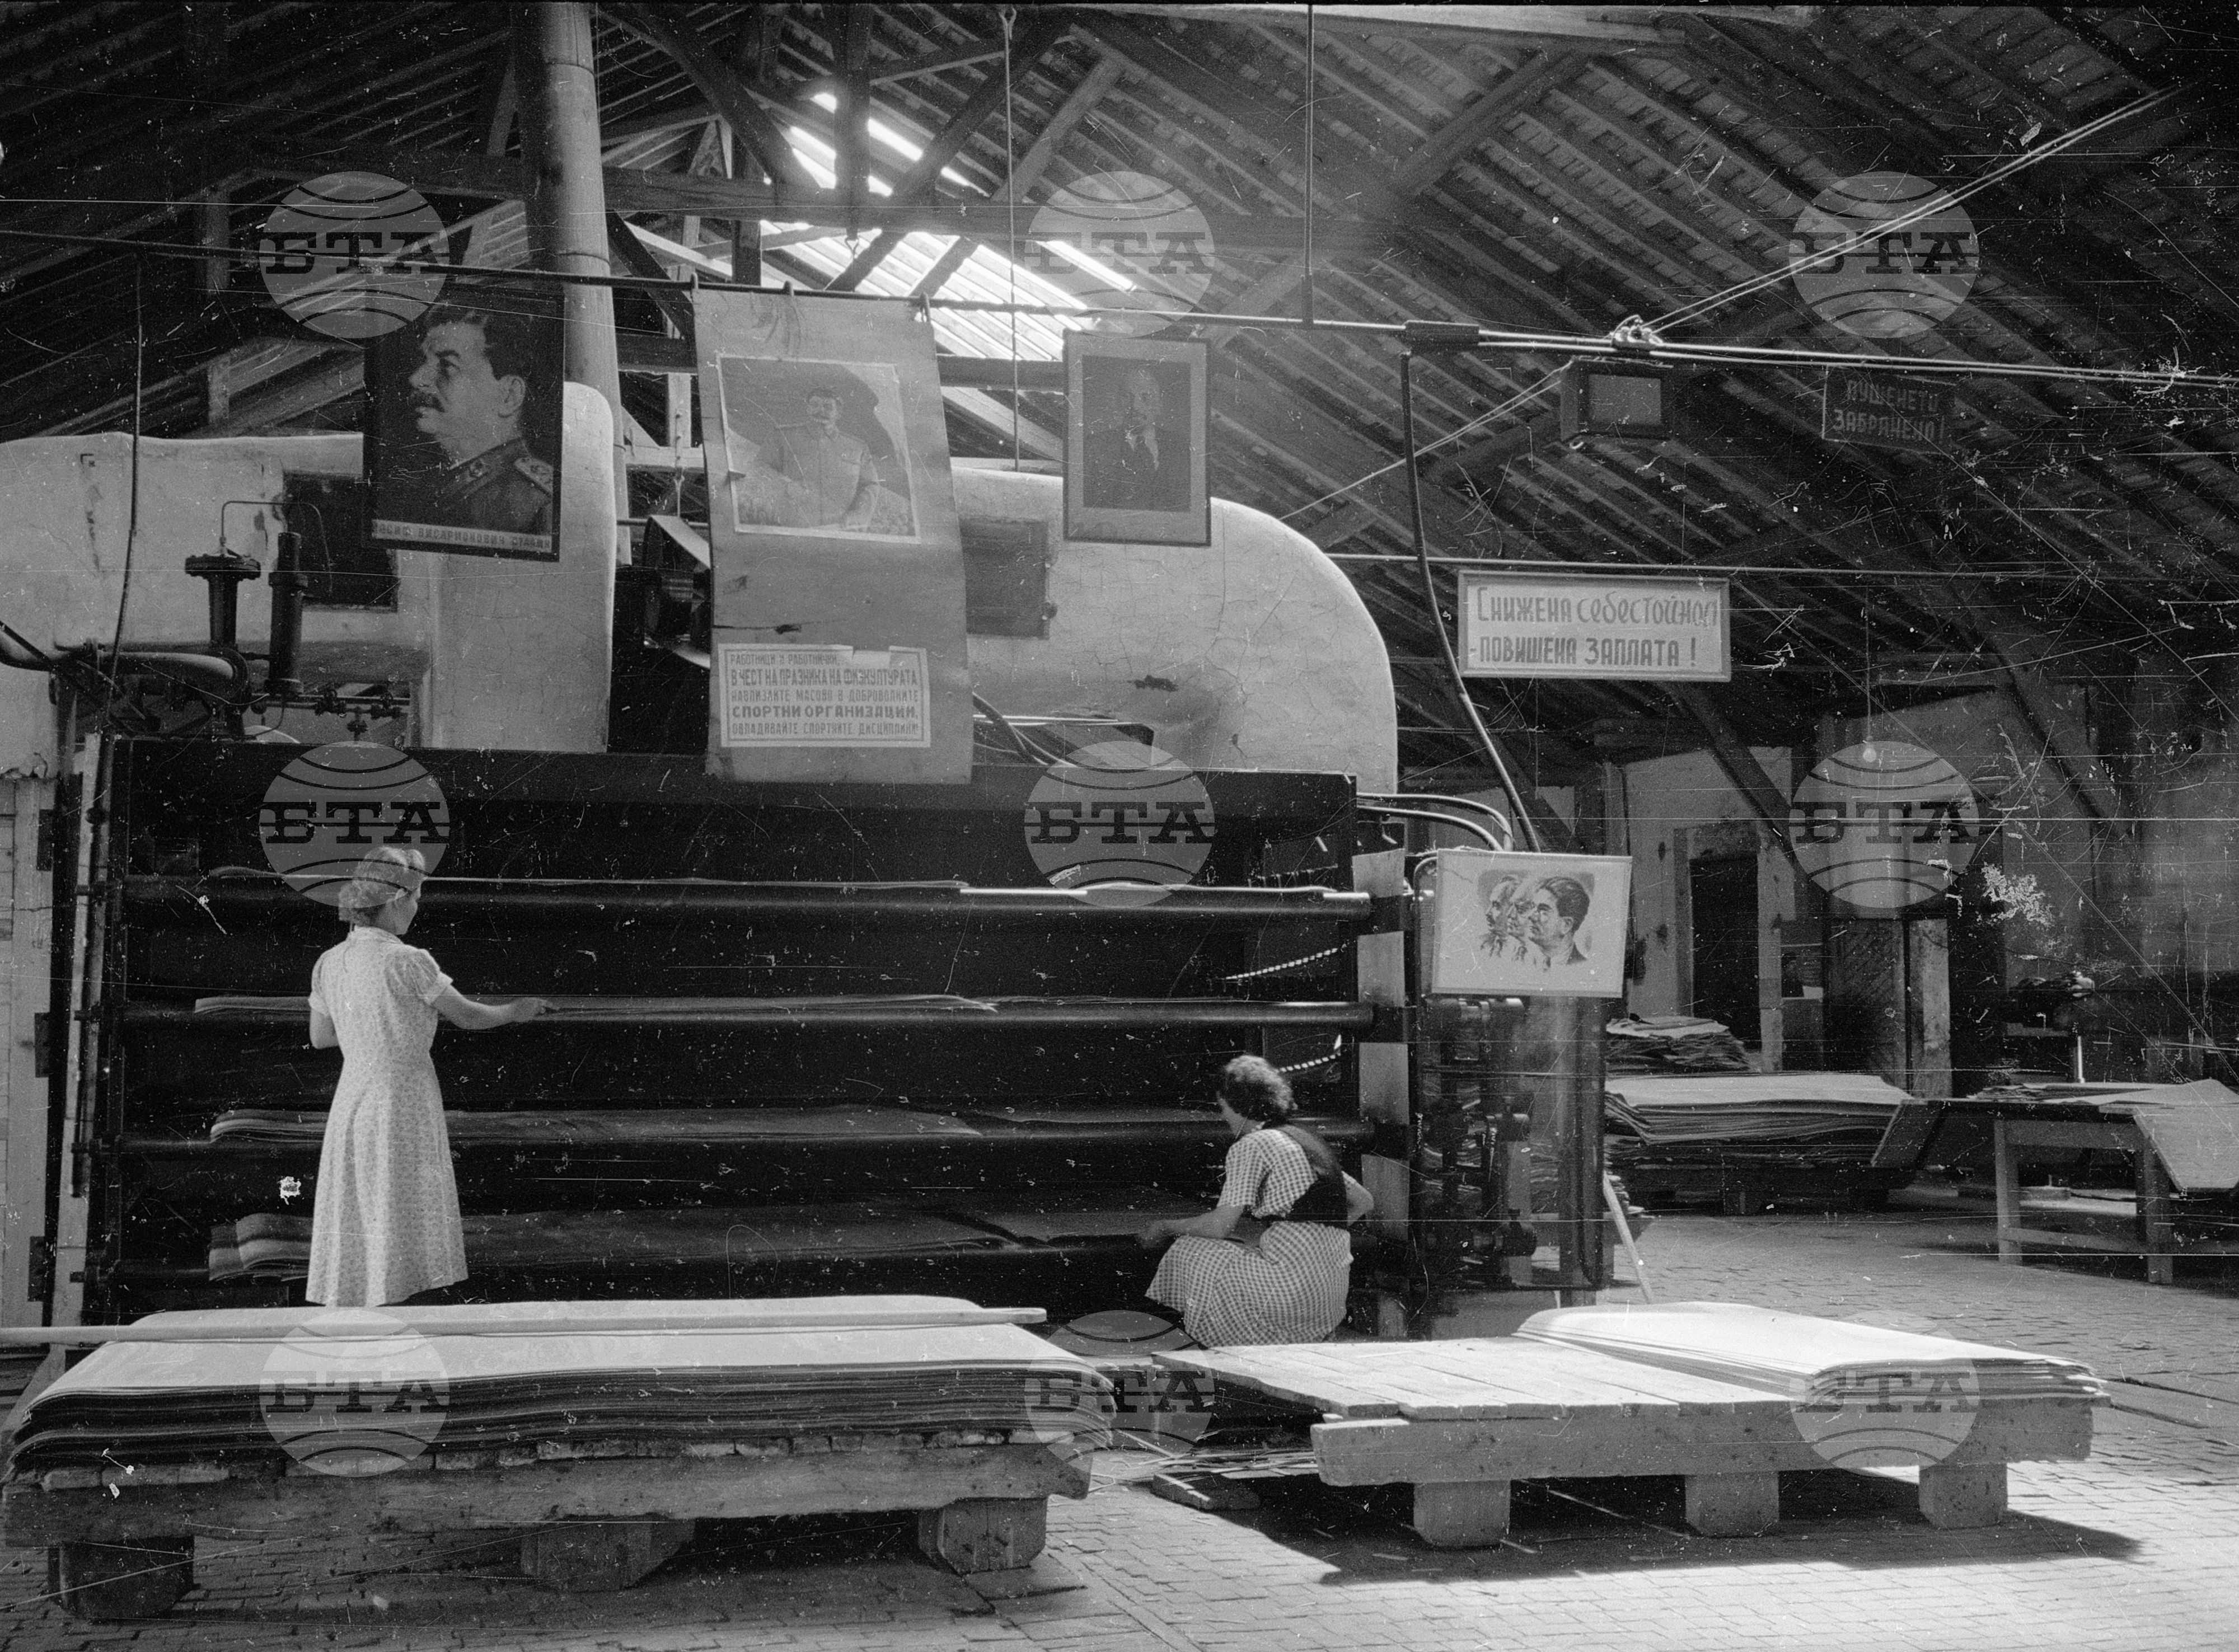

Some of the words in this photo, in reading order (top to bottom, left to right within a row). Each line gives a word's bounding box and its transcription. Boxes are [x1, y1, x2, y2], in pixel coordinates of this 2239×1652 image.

[1480, 635, 1577, 664] ПОВИШЕНА
[730, 654, 776, 665] РАБОТНИЦИ
[731, 669, 737, 686] В
[739, 669, 762, 686] ЧЕСТ
[765, 669, 777, 686] НА
[780, 669, 827, 686] ПРАЗНИКА
[830, 669, 841, 686] НА
[844, 669, 917, 686] ФИЗКУЛТУРАТА
[796, 689, 833, 702] МАСОВО
[838, 689, 843, 702] В
[849, 689, 919, 702] ДОБРОВОЛНИТЕ
[732, 706, 801, 718] СПОРТНИ
[803, 722, 852, 735] СПОРТНИТЕ
